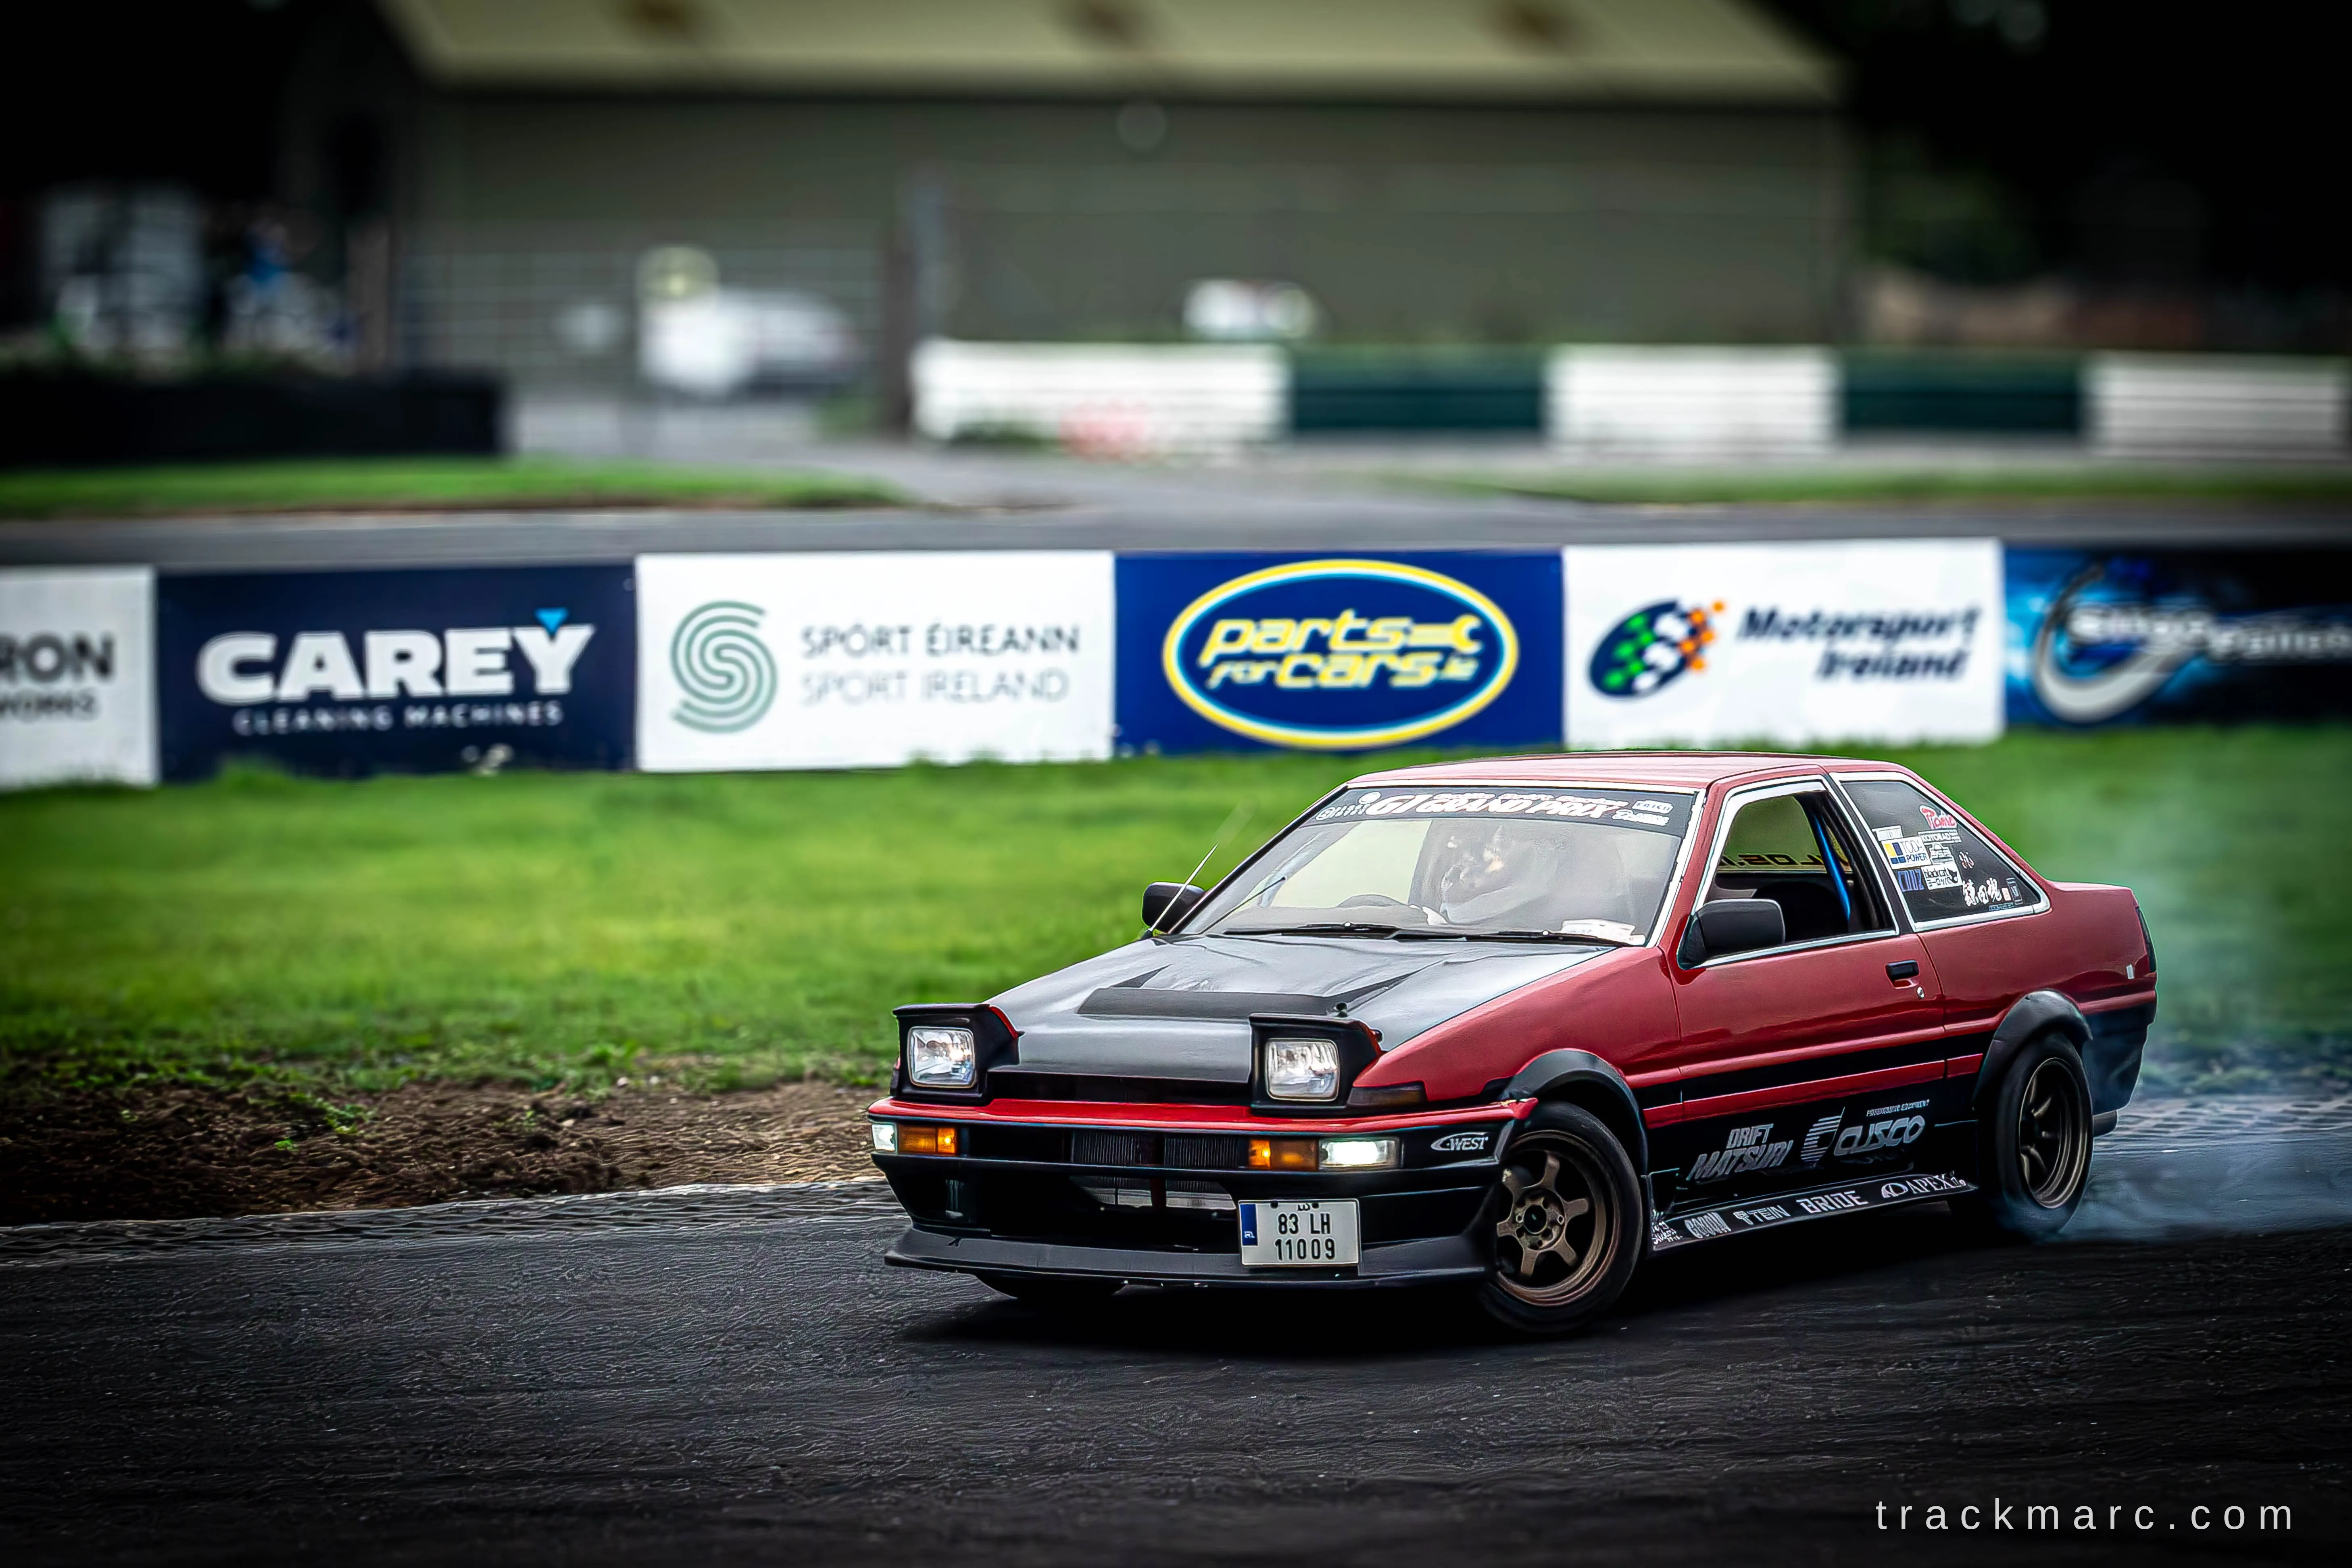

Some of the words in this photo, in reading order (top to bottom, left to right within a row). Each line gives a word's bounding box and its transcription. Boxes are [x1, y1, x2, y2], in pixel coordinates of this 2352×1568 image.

[802, 619, 910, 658] SPÓRT
[926, 618, 1080, 657] ÉIREANN
[1199, 609, 1413, 667] parts
[1737, 605, 1981, 644] Motorsport
[197, 625, 595, 704] CAREY
[1816, 648, 1969, 680] Ireland
[802, 671, 907, 705] SPORT
[922, 668, 1069, 703] IRELAND
[233, 707, 393, 736] CLEANING
[405, 700, 563, 728] MACHINES
[1416, 798, 1533, 813] GRAND
[1524, 800, 1621, 818] PRIX
[1900, 840, 1925, 853] TODA
[1906, 853, 1928, 862] POWER
[1726, 1123, 1774, 1149] DRIFT
[1686, 1140, 1794, 1180] MATSURI
[1796, 1191, 1869, 1214] BRIDE
[1278, 1213, 1299, 1234] 83
[1310, 1213, 1330, 1234] LH
[1275, 1238, 1335, 1261] 11009
